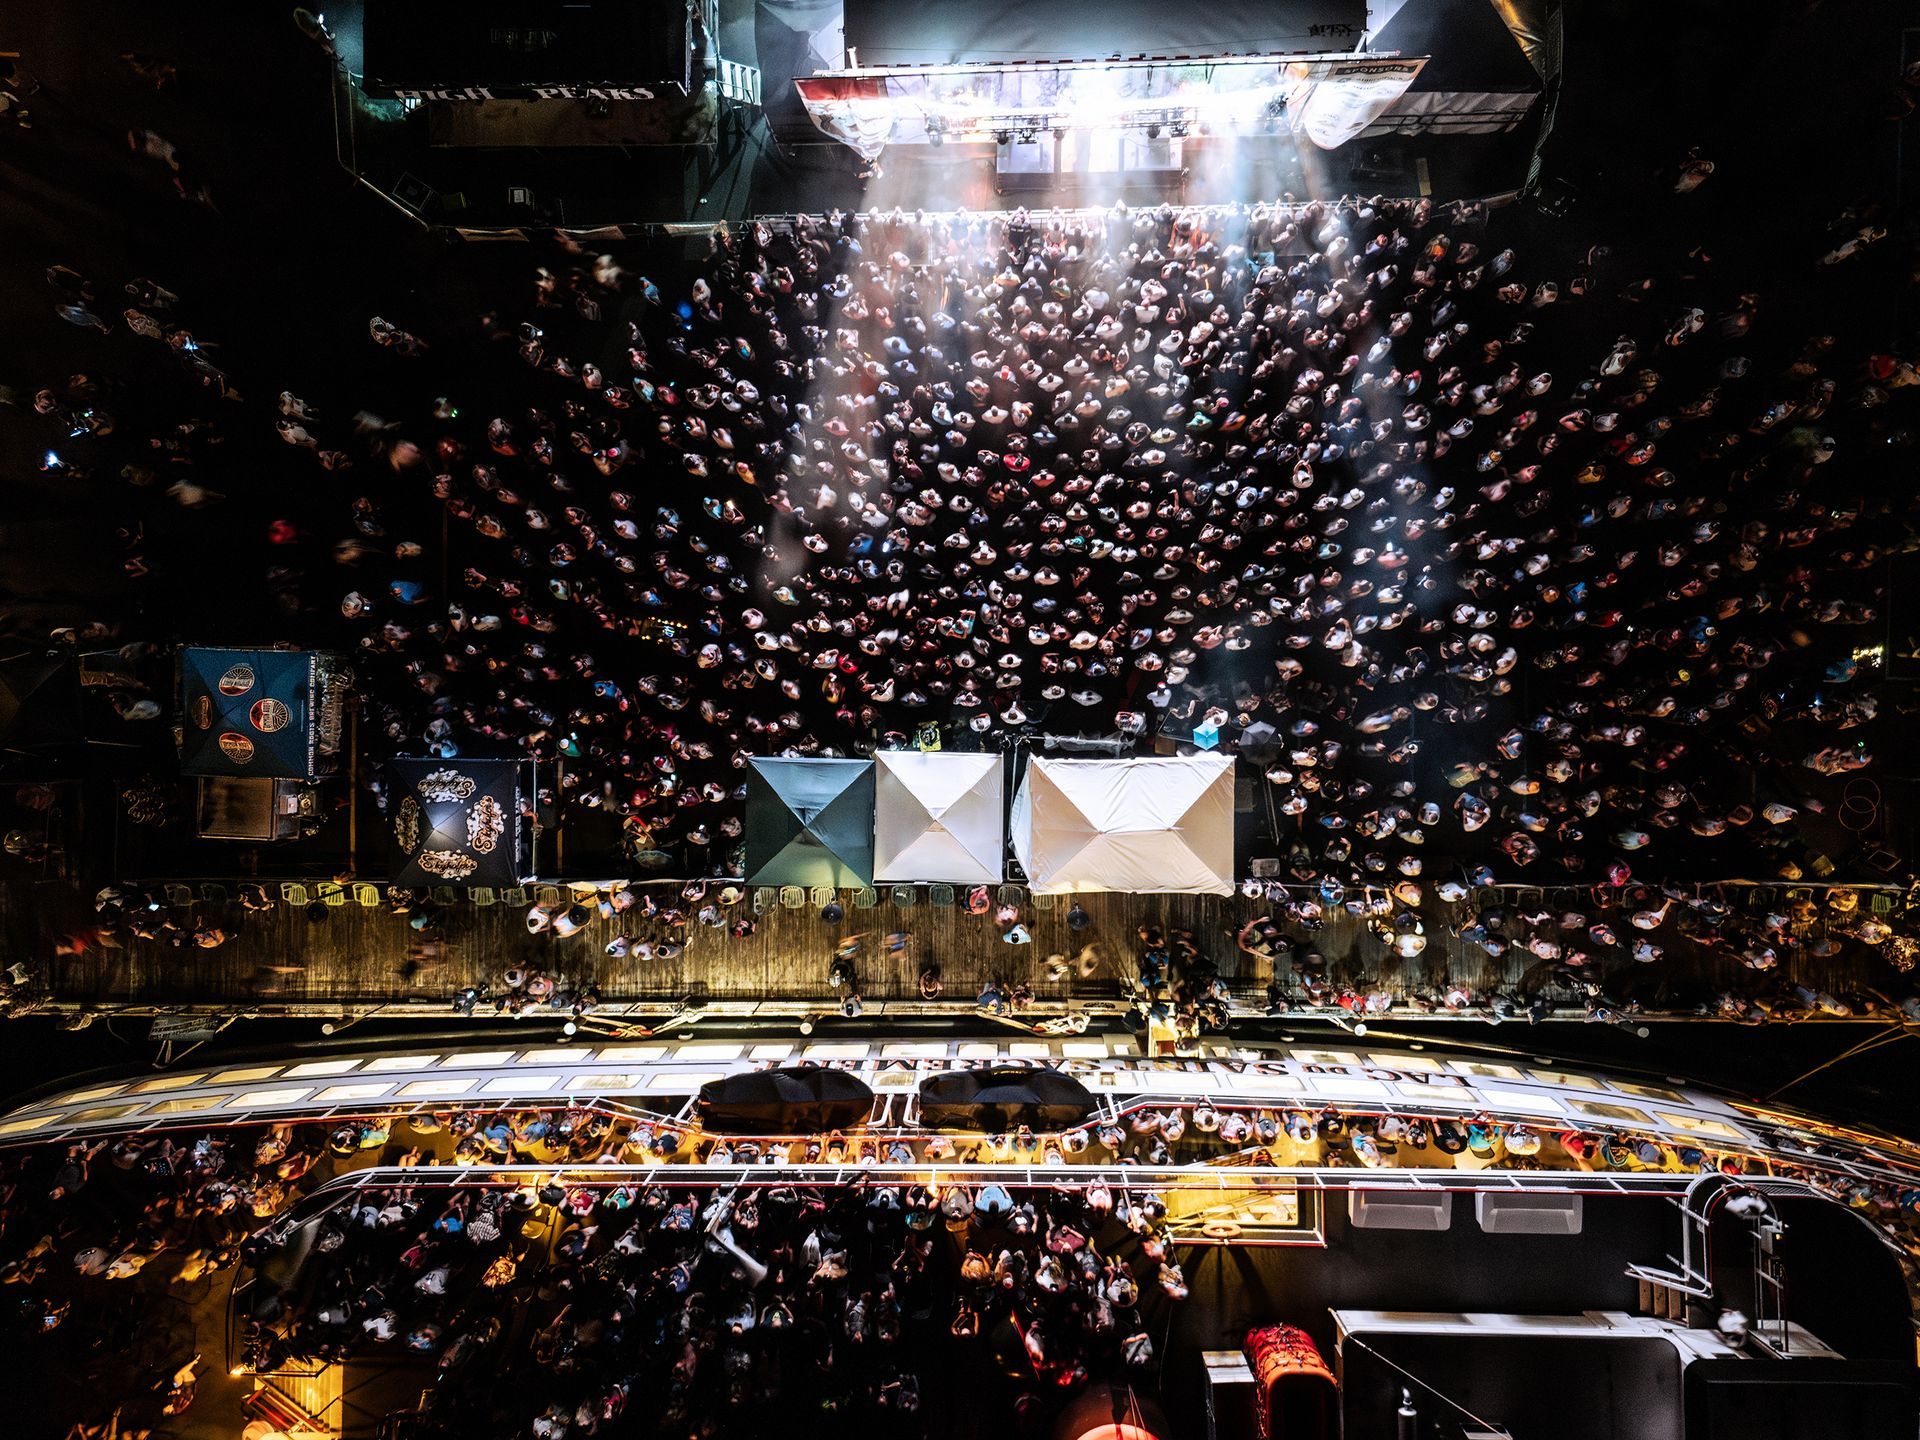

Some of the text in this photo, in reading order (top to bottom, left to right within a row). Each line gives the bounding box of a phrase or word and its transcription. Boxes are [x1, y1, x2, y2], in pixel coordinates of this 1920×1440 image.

[1310, 24, 1353, 36] APEX
[1344, 66, 1409, 75] SPONSORS
[394, 86, 656, 101] HIGH PEAKS
[307, 746, 315, 776] COMMON
[1302, 1063, 1351, 1076] DU
[1361, 1067, 1477, 1089] LAC
